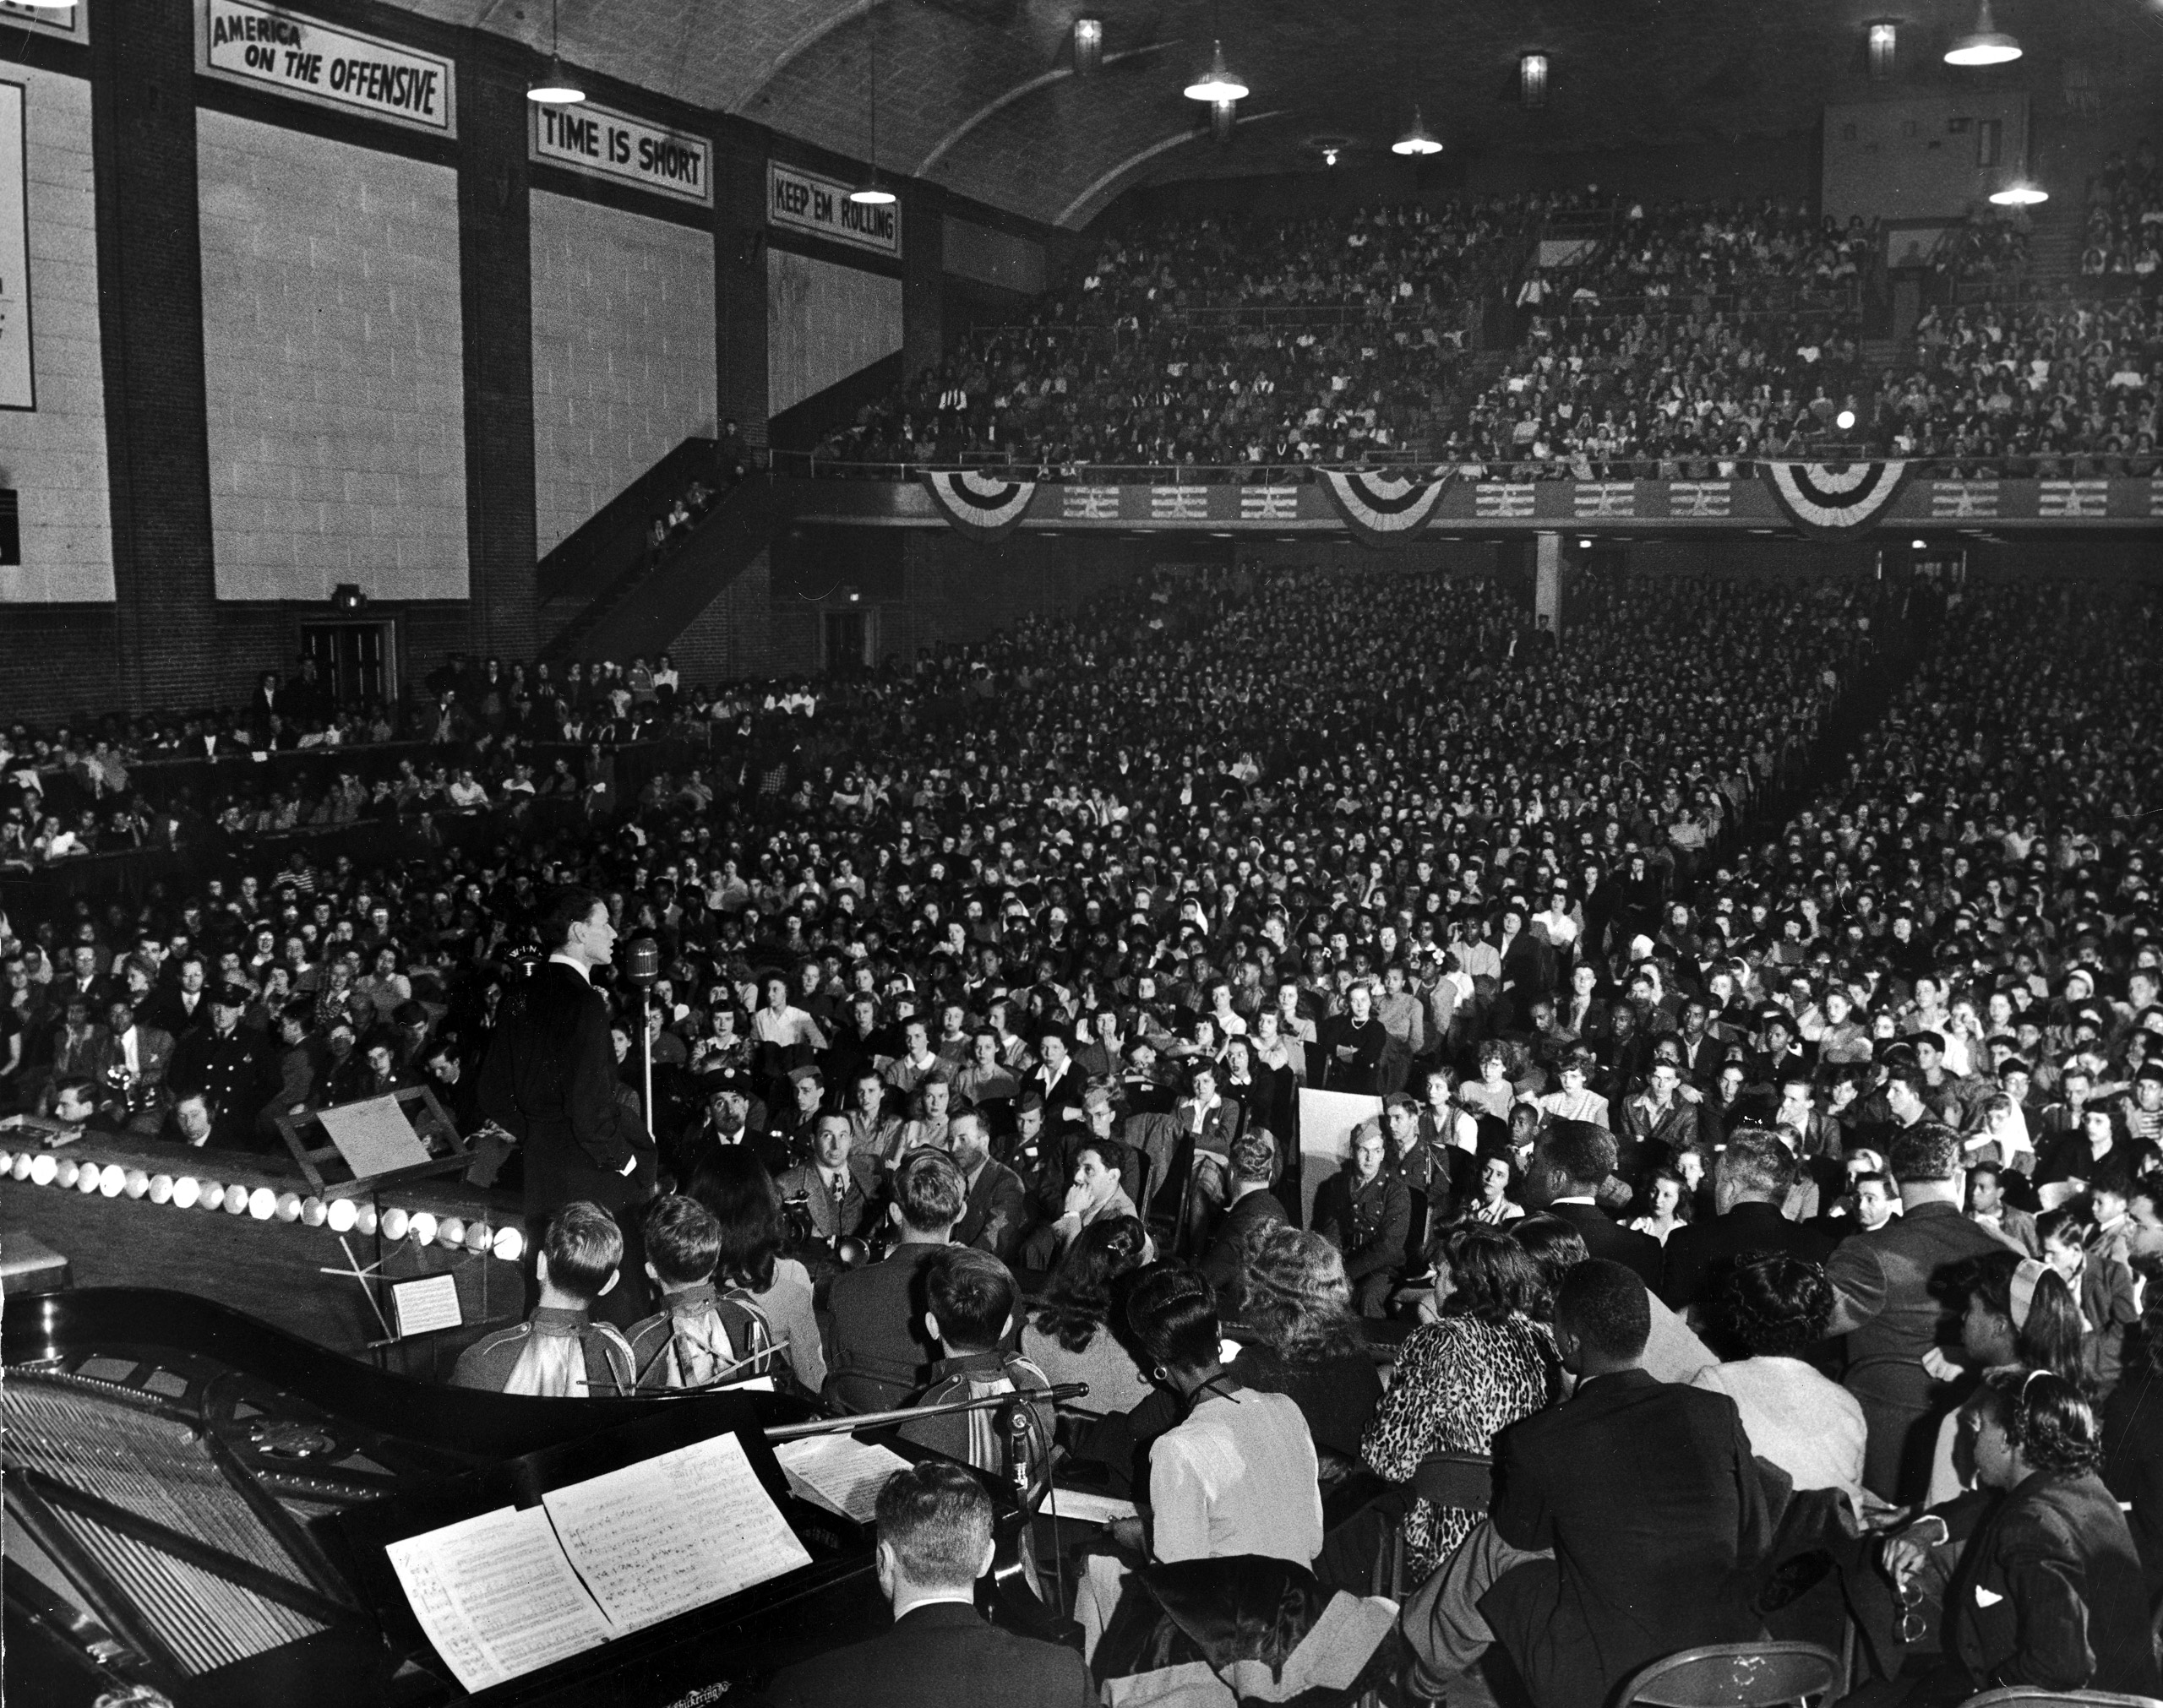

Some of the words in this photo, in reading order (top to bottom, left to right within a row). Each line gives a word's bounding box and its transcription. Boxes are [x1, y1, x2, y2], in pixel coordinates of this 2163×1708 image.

[213, 15, 302, 51] AMERICA
[244, 44, 276, 73] ON
[285, 51, 323, 84] THE
[330, 57, 438, 116] OFFENSIVE
[542, 106, 599, 157] TIME
[608, 127, 630, 164] IS
[639, 137, 701, 186] SHORT
[776, 178, 809, 215] KEEP
[841, 197, 894, 240] ROLLING
